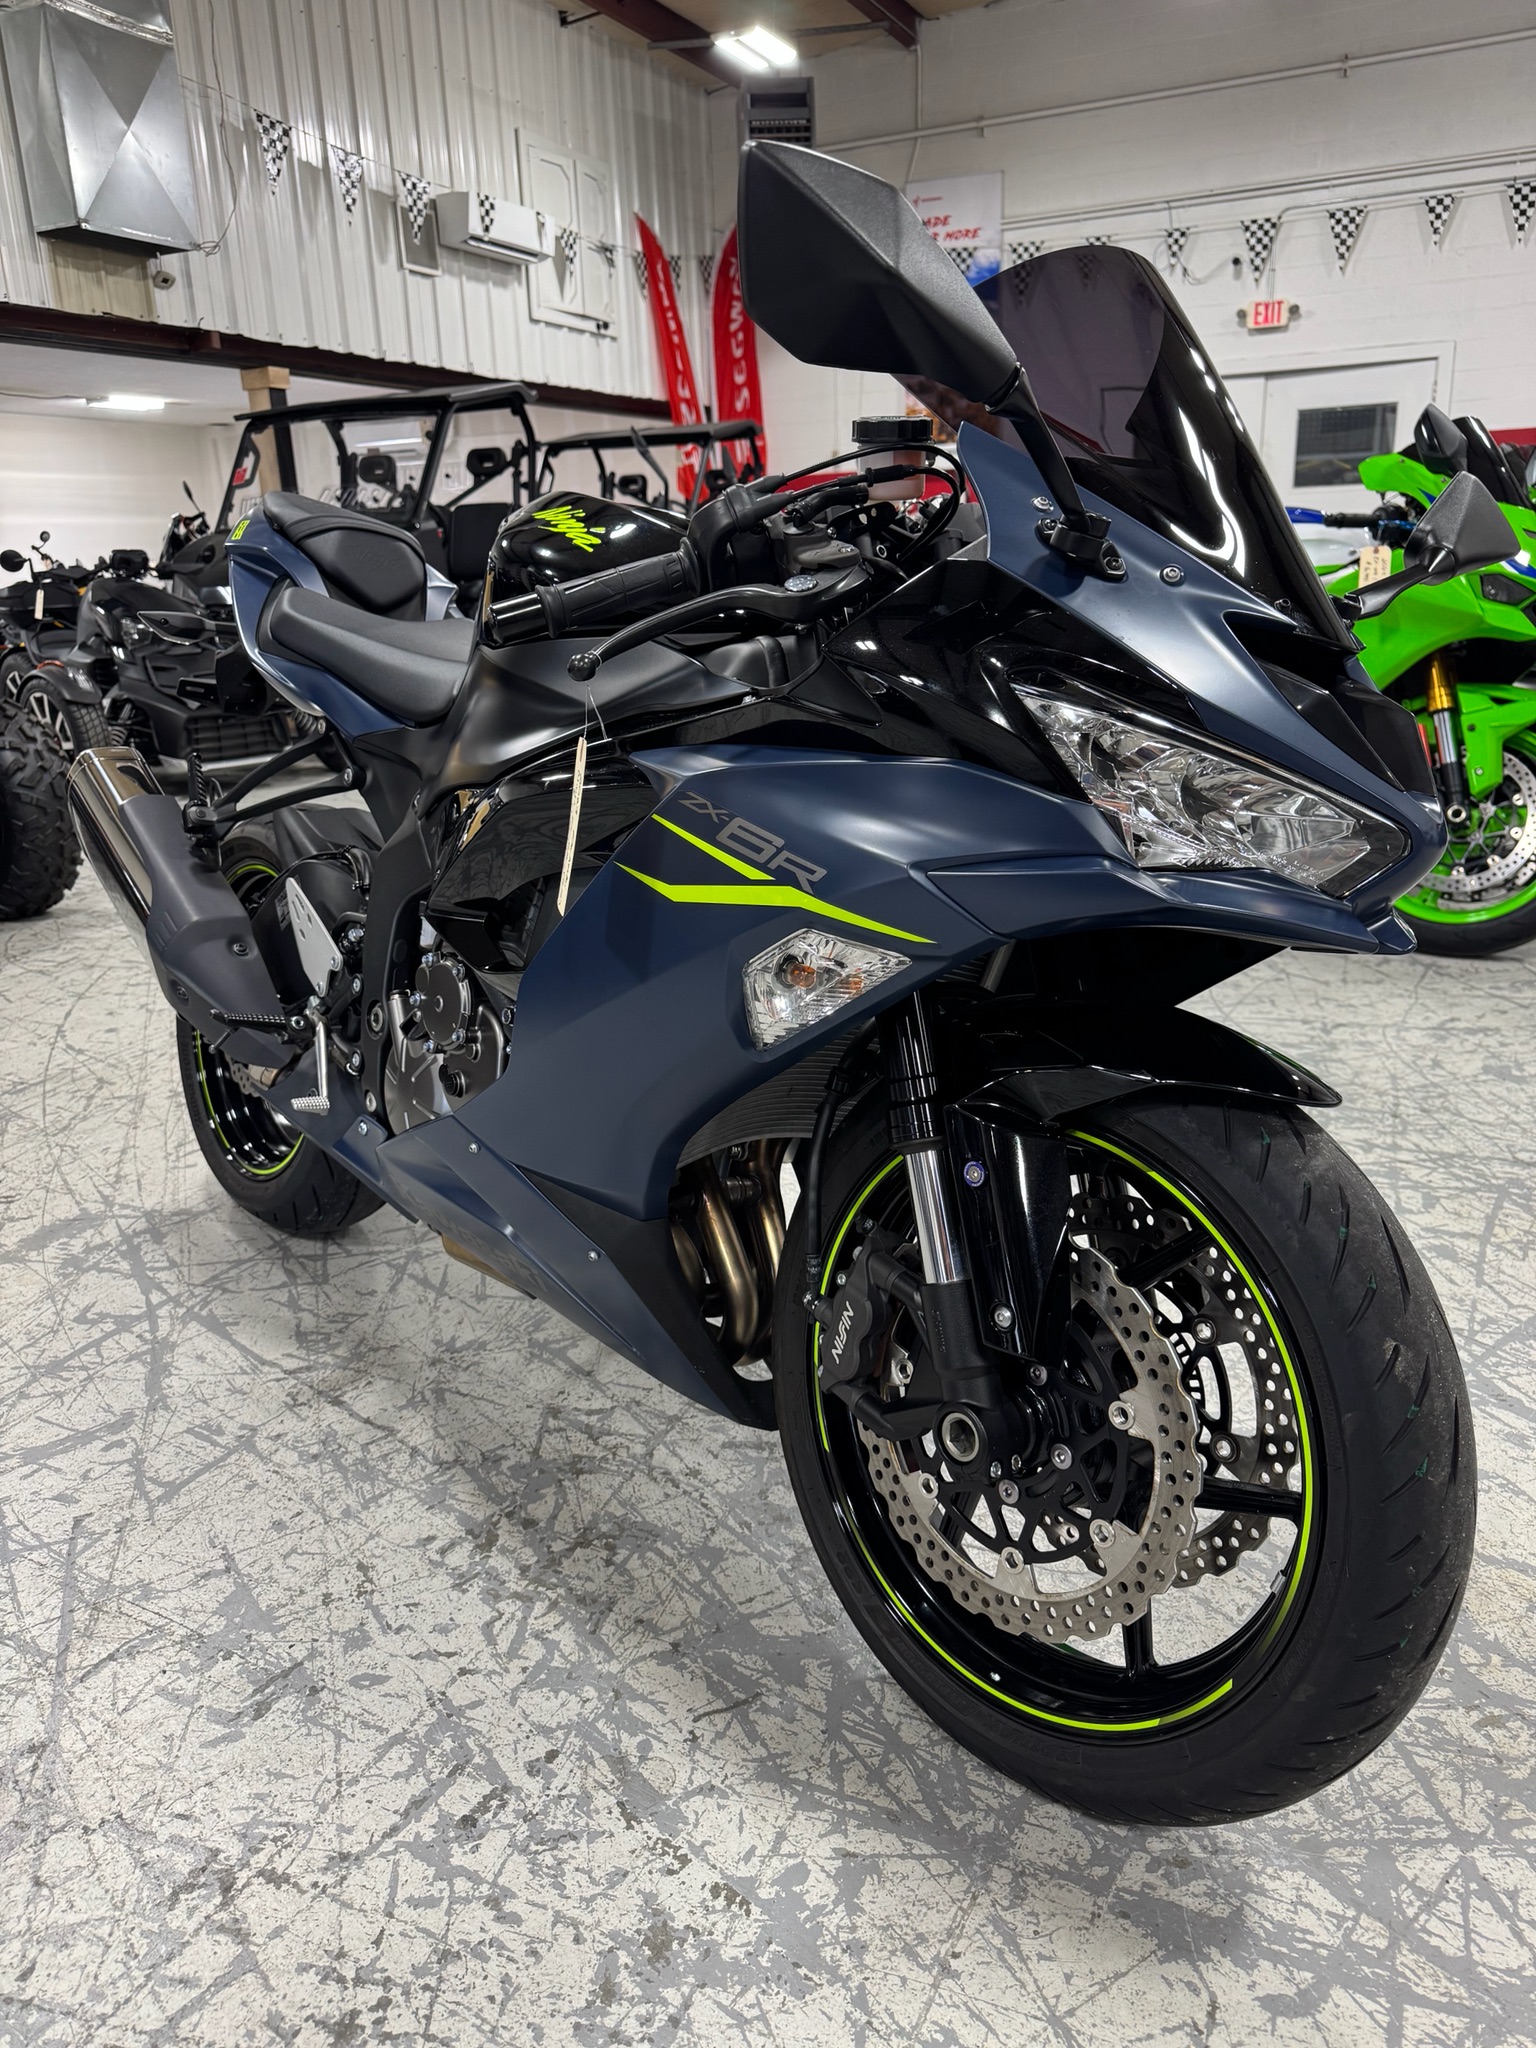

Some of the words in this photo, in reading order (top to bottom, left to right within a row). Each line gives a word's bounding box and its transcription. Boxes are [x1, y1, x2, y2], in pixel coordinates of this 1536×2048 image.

[924, 215, 951, 228] ADE
[944, 227, 981, 241] MORE
[1253, 300, 1284, 326] EXIT
[532, 505, 606, 553] Ninja
[678, 791, 828, 895] ZX-6R
[831, 1300, 855, 1365] NISSIN
